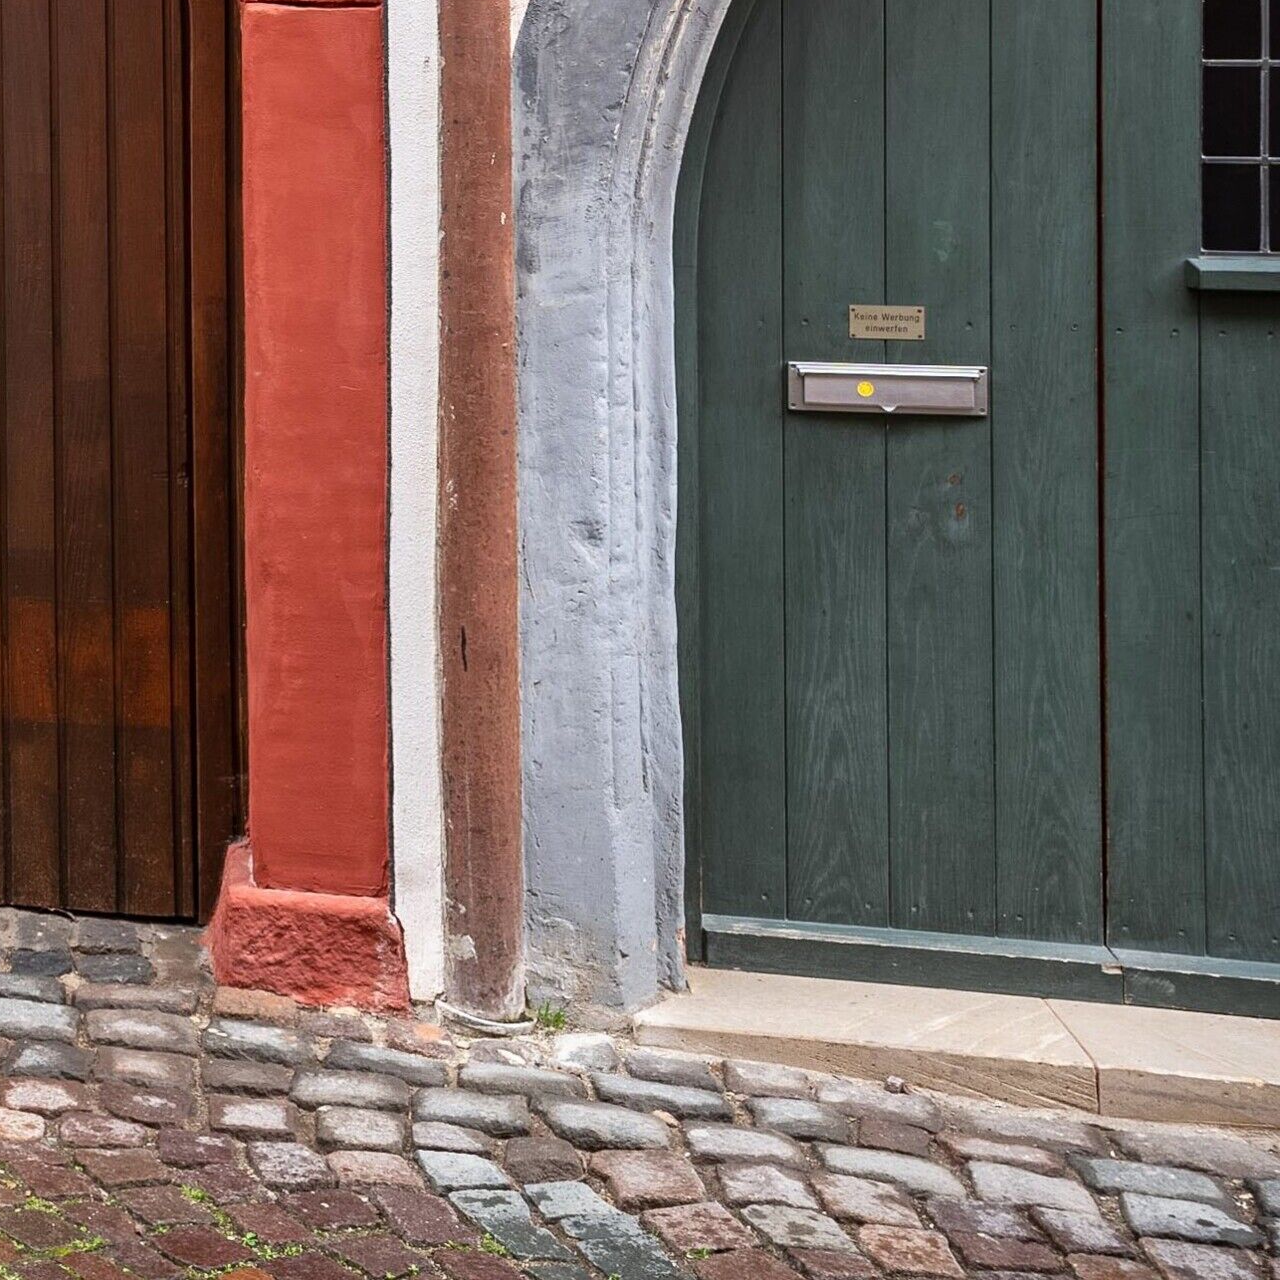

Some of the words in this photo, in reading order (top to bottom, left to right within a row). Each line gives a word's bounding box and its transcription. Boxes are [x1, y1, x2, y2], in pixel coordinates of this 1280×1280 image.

[854, 313, 878, 321] Keine
[882, 313, 920, 323] Werbung
[865, 325, 908, 333] einwerfen
